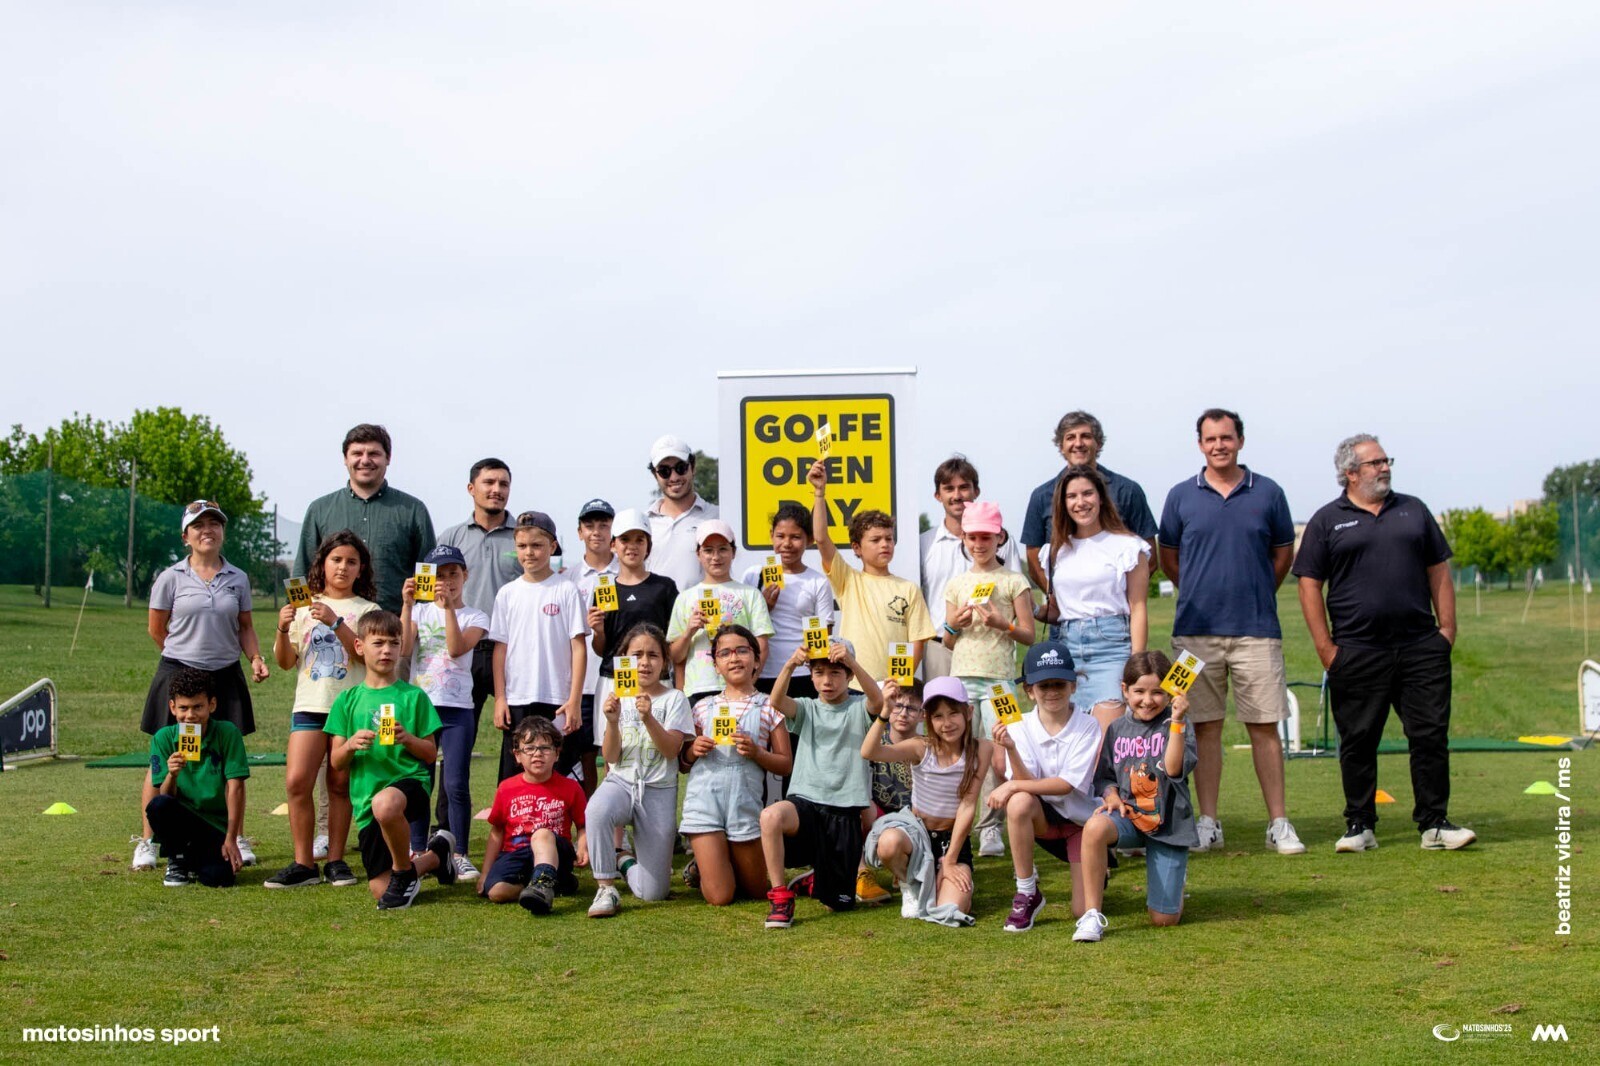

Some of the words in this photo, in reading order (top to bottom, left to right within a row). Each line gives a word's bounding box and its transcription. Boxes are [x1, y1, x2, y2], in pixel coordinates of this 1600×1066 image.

[765, 567, 778, 575] EU
[417, 576, 430, 584] EU
[765, 575, 782, 583] FUI
[289, 588, 304, 596] EU
[416, 584, 433, 592] FUI
[598, 587, 611, 595] EU
[291, 593, 309, 602] FUI
[598, 595, 615, 603] FUI
[701, 600, 714, 609] EU
[702, 608, 718, 616] UI
[806, 630, 822, 640] EU
[807, 640, 827, 649] FUI
[891, 657, 907, 667] EU
[617, 670, 632, 680] EU
[891, 667, 911, 676] FUI
[1173, 665, 1190, 679] EU
[617, 679, 636, 688] FUI
[1168, 673, 1188, 690] FUI
[994, 696, 1010, 708] EU
[997, 704, 1017, 717] FUI
[382, 718, 392, 727] EU
[716, 718, 730, 728] EU
[381, 727, 393, 736] FUI
[181, 736, 195, 744] EU
[181, 745, 199, 753] FUI
